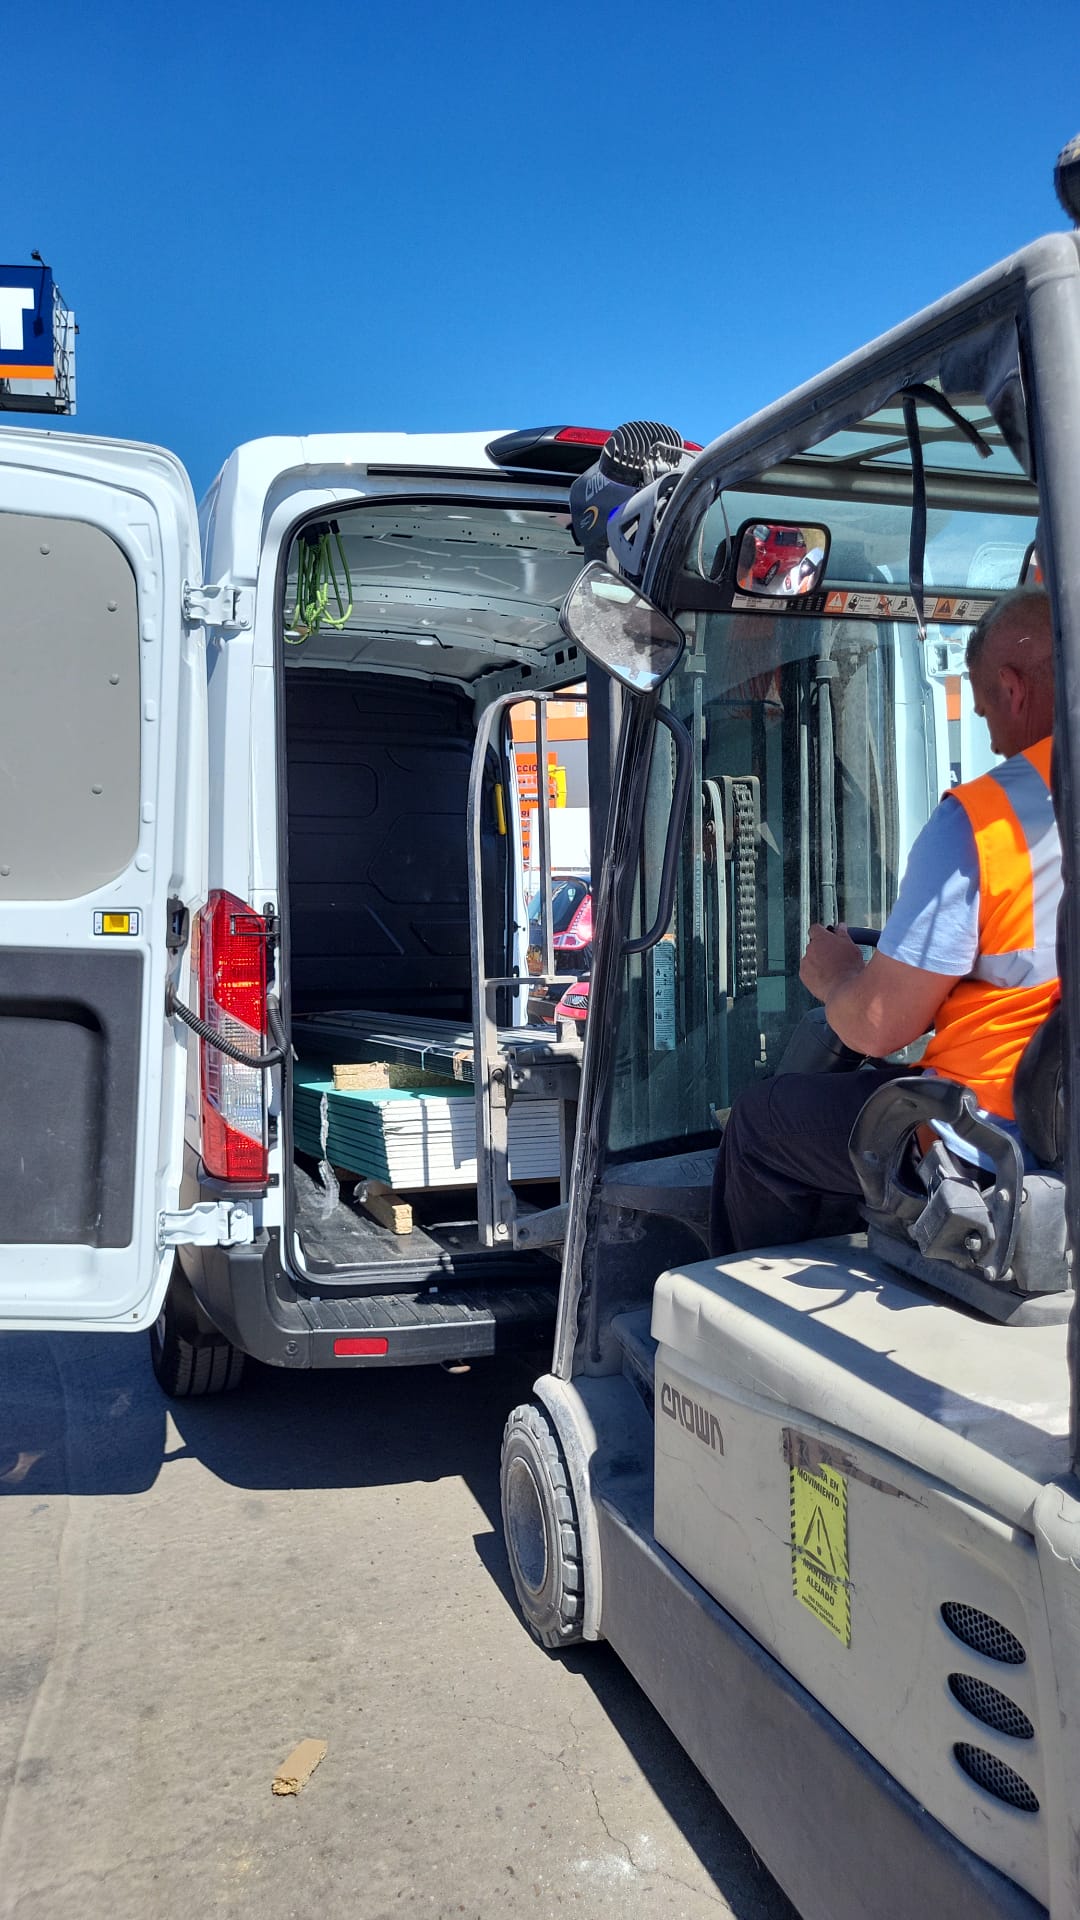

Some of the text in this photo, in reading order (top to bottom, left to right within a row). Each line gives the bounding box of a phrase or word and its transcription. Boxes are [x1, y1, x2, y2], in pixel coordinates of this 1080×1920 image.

[661, 1382, 725, 1457] CROWN
[797, 1468, 840, 1507] MOVIMIENTO
[830, 1478, 839, 1492] EN
[806, 1575, 835, 1607] ALEJADO
